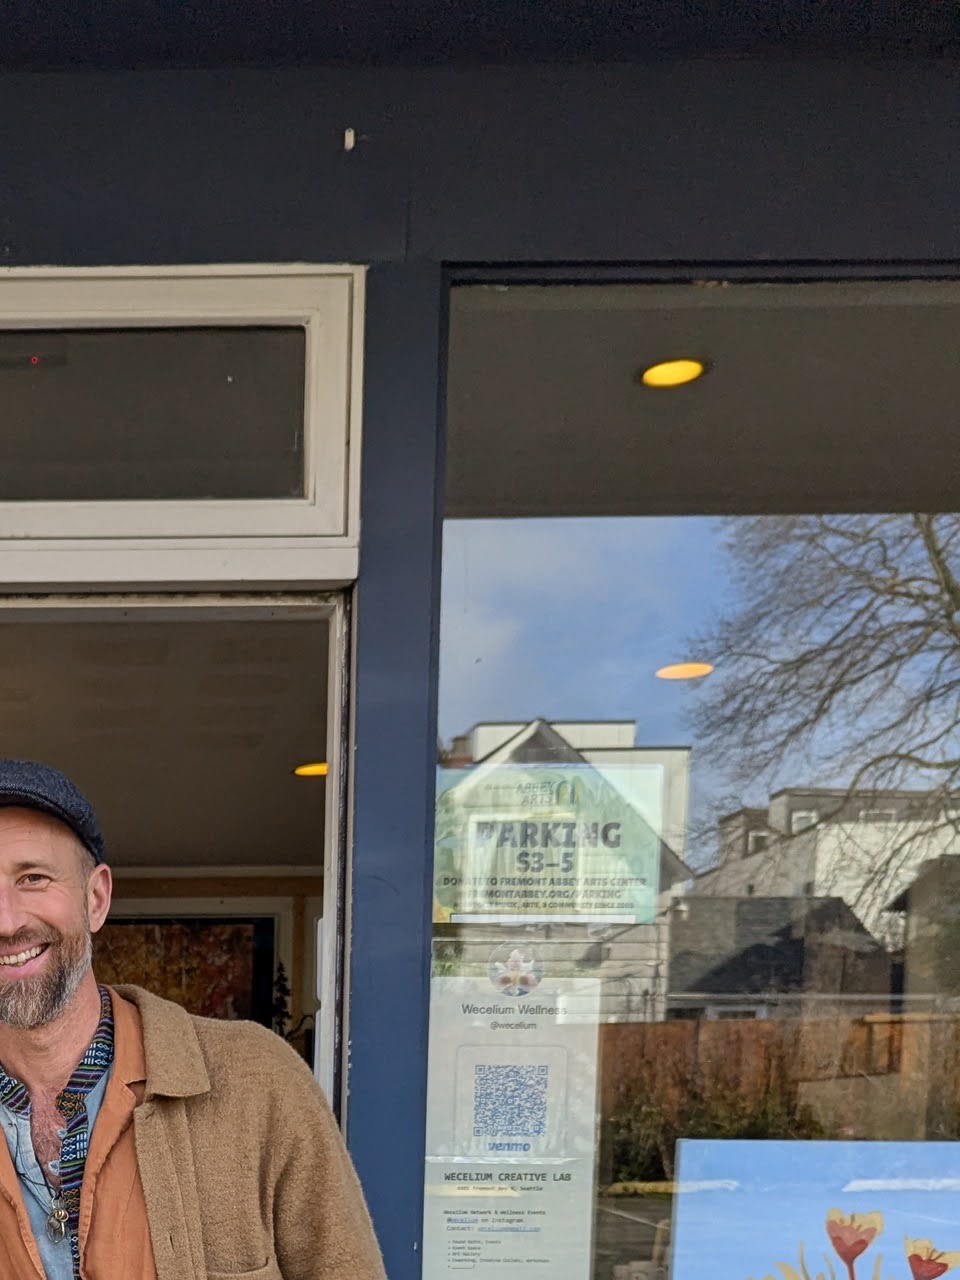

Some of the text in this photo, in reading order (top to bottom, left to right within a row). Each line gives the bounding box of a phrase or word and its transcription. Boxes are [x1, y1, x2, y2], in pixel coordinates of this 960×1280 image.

[476, 821, 622, 848] PARKING
[500, 877, 547, 886] FREMONT
[549, 877, 580, 886] ABBEY
[583, 878, 608, 887] ARTS
[610, 878, 647, 887] CENTER
[462, 1004, 567, 1015] Wecelium Wellness
[490, 1022, 537, 1030] @wecelium
[488, 1142, 531, 1152] venmo
[444, 1172, 572, 1182] WECELIUM CREATIVE LAB
